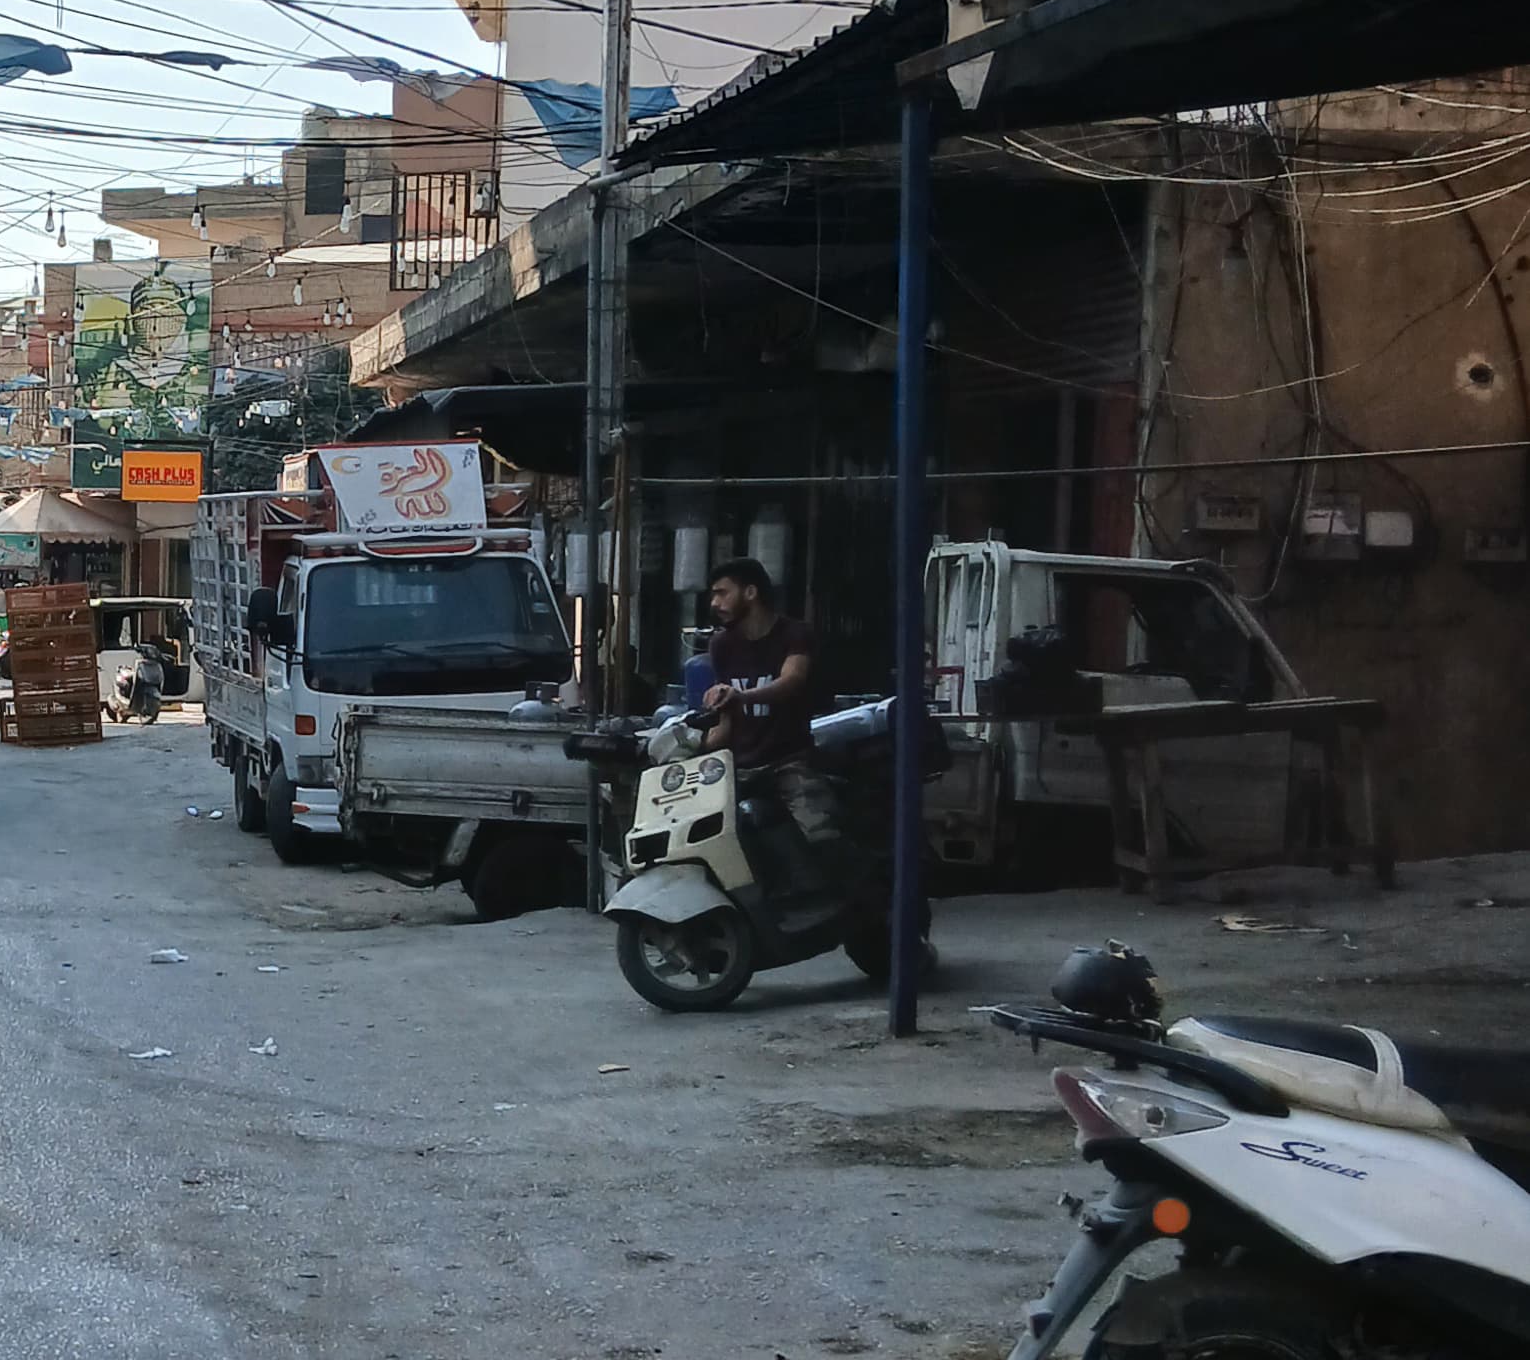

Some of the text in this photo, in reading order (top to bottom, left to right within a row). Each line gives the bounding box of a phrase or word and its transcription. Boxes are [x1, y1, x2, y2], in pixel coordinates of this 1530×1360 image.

[128, 467, 195, 481] CASH PLUS
[1239, 1141, 1369, 1181] Sweet
